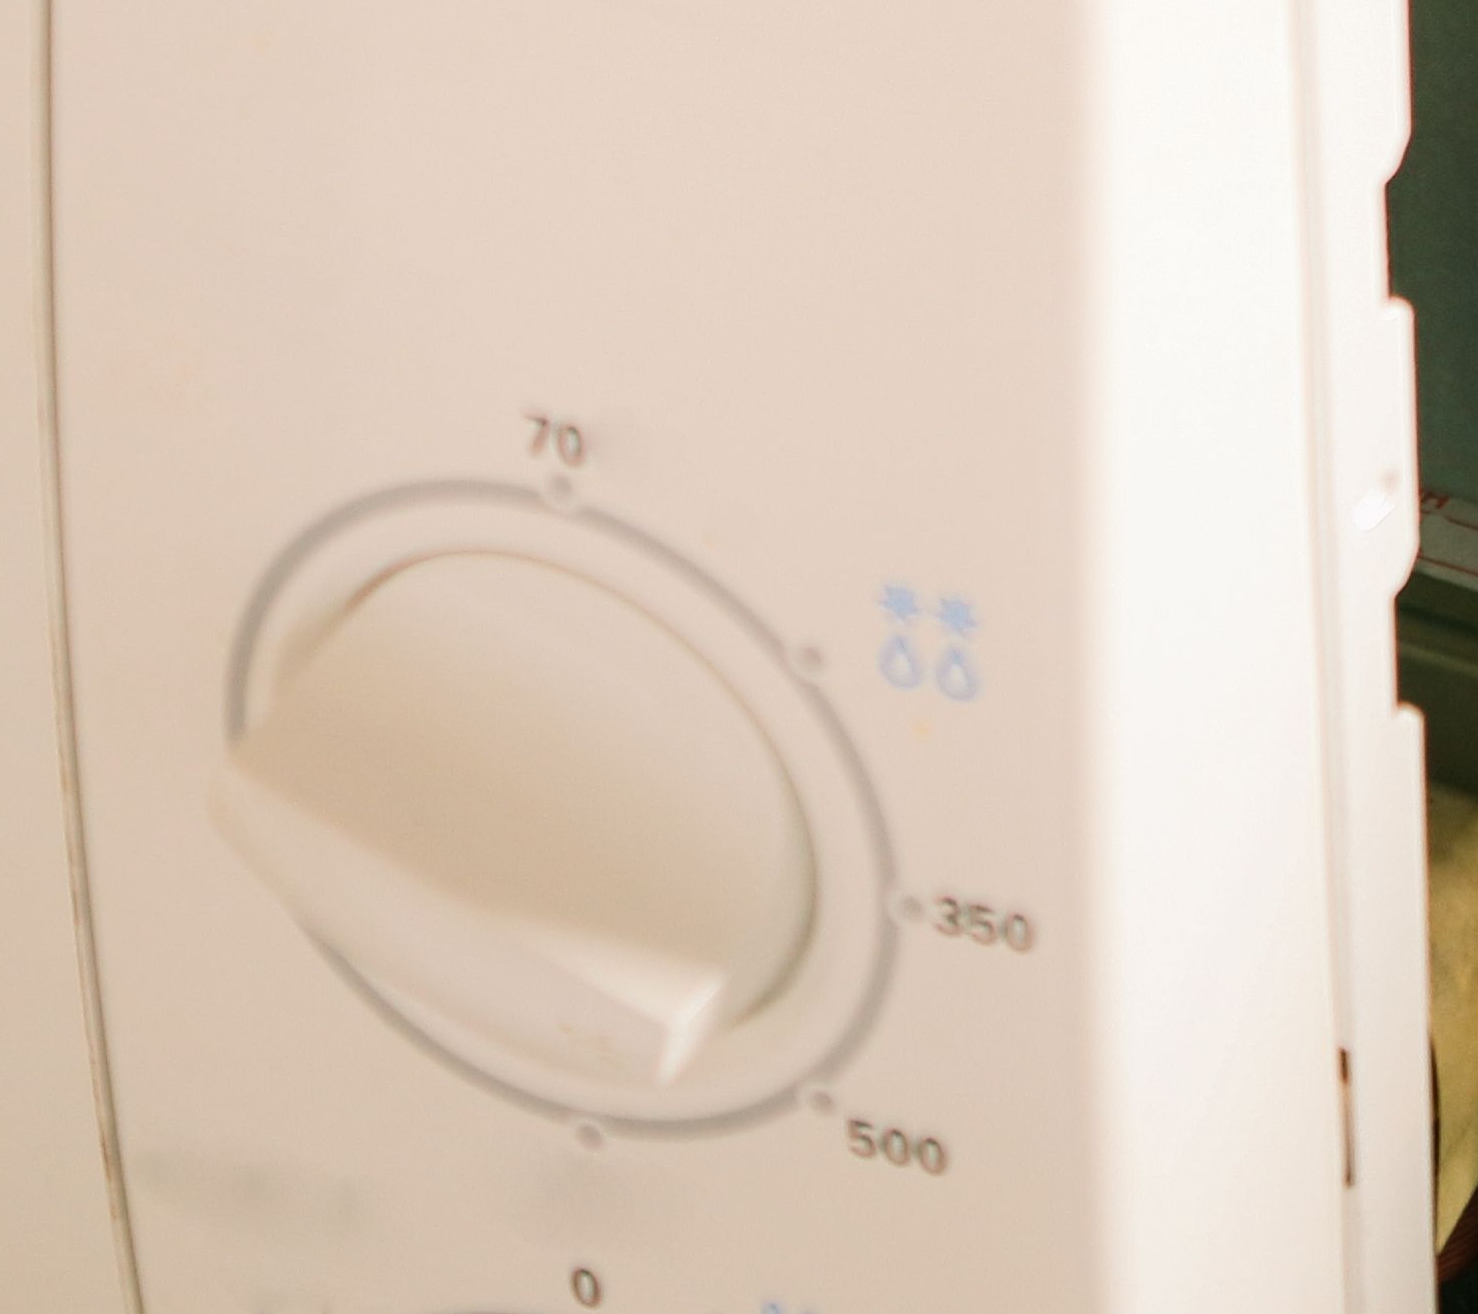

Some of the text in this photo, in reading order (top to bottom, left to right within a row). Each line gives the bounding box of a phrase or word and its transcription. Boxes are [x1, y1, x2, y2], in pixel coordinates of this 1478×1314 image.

[524, 412, 587, 467] 70
[933, 896, 1037, 954] 350
[846, 1120, 950, 1176] 500
[570, 1266, 602, 1310] 0
